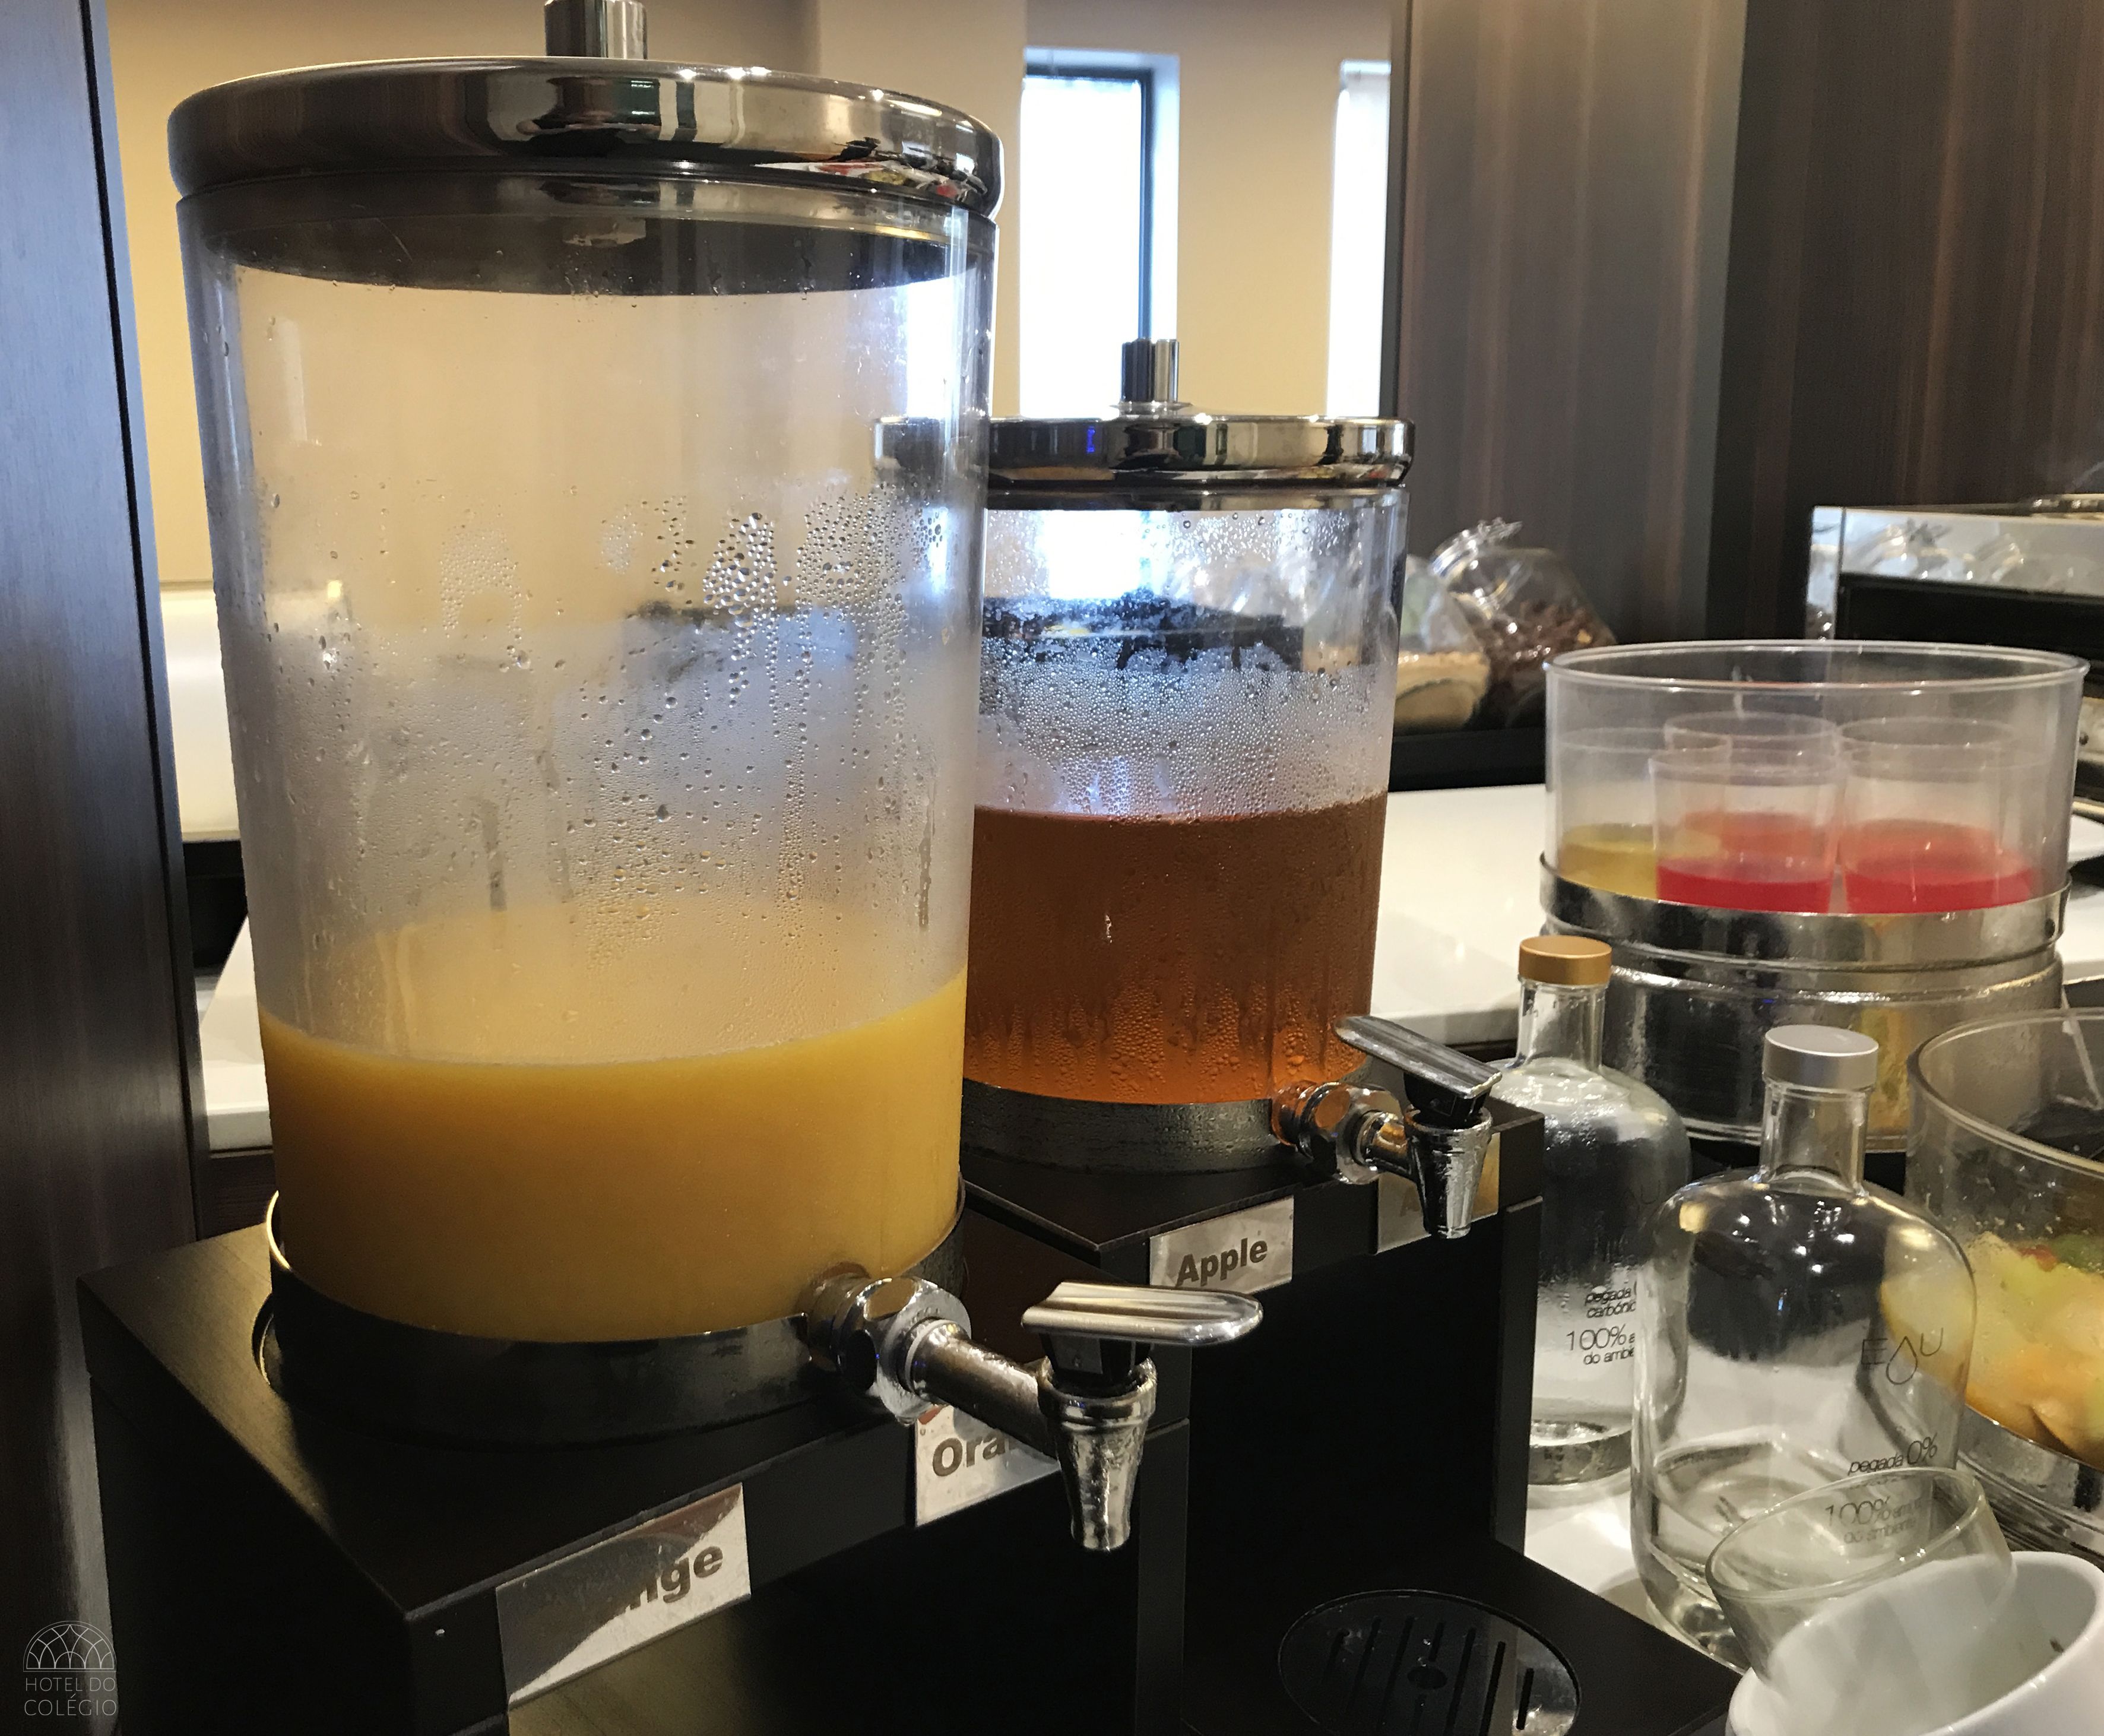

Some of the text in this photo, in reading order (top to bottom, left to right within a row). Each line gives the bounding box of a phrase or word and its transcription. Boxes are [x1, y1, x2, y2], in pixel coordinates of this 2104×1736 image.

[1175, 1238, 1268, 1287] Apple
[1584, 1287, 1631, 1307] pegada
[1566, 1323, 1627, 1351] 100%
[1583, 1351, 1601, 1365] do
[1861, 1327, 1944, 1385] EAU
[932, 1427, 1021, 1477] Ora
[1907, 1432, 1938, 1465] 0%
[1825, 1496, 1891, 1527] 100%
